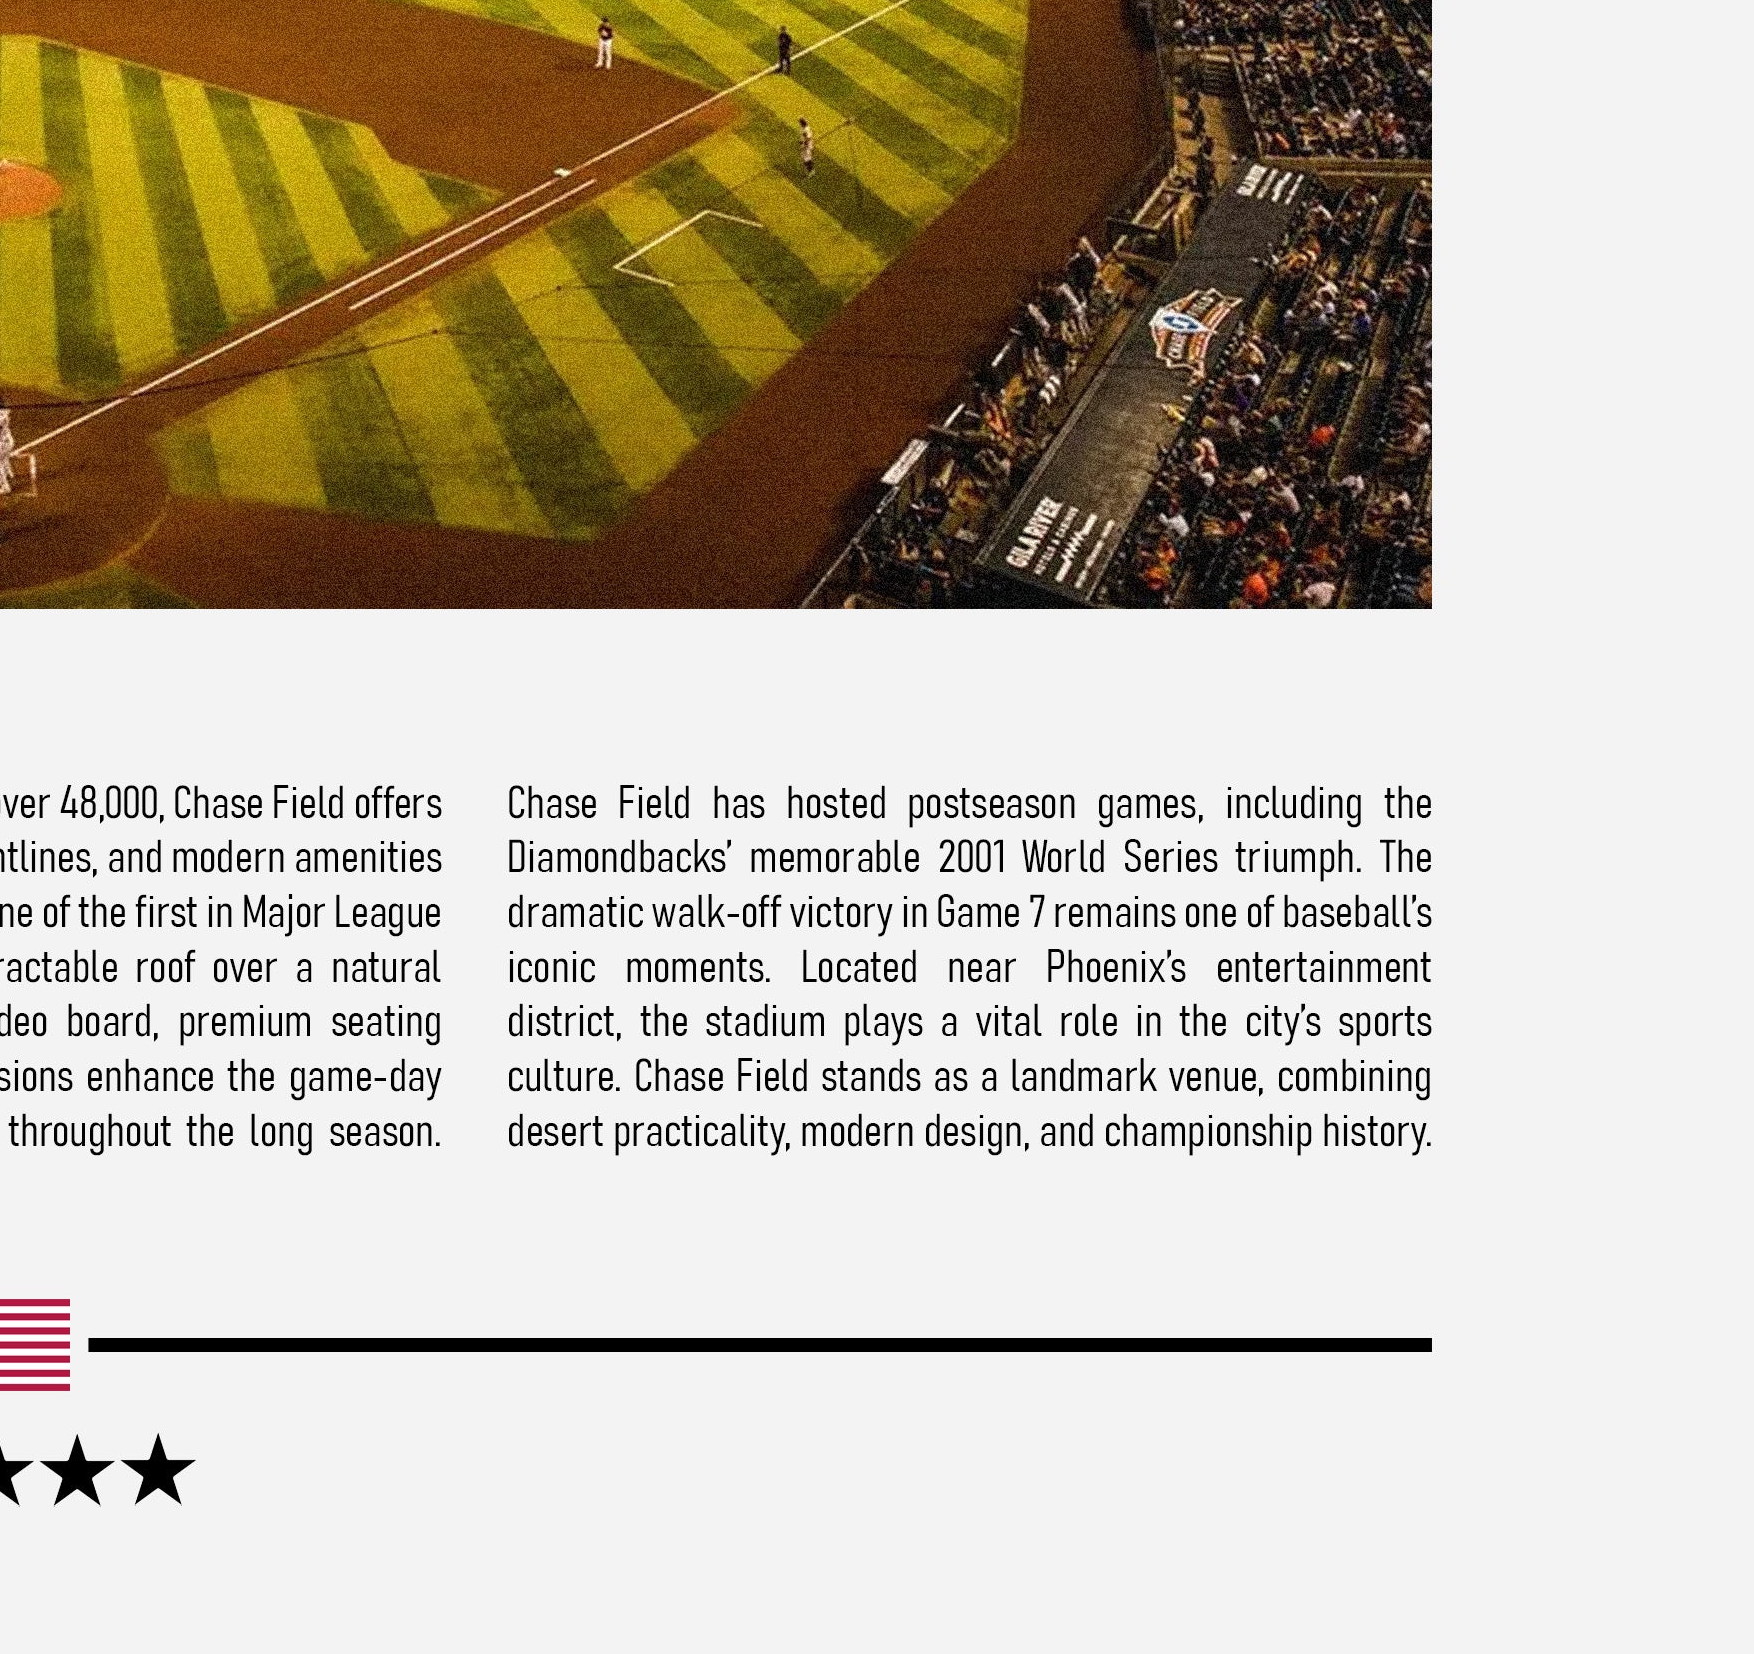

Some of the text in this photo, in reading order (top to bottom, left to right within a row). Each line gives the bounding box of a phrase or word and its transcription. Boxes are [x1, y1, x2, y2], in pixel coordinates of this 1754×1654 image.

[61, 785, 164, 824] 48,000,
[175, 785, 262, 818] Chase
[274, 785, 343, 818] Field
[356, 786, 441, 818] offers
[509, 785, 1431, 827] Chase Field has hosted postseason games, including the
[44, 895, 70, 927] of
[79, 895, 125, 927] the
[136, 895, 197, 927] first
[209, 896, 232, 927] in
[244, 894, 325, 936] Major
[336, 895, 440, 936] League
[509, 894, 1431, 936] dramatic walk-off victory in Game 7 remains one of baseball’s
[510, 949, 1431, 982] iconic moments. Located near Phoenix’s entertainment
[9, 1114, 171, 1155] throughout
[187, 1114, 233, 1146] the
[252, 1114, 312, 1155] long
[330, 1123, 440, 1146] season.
[509, 1114, 1431, 1156] desert practicality, modern design, and championship history.
